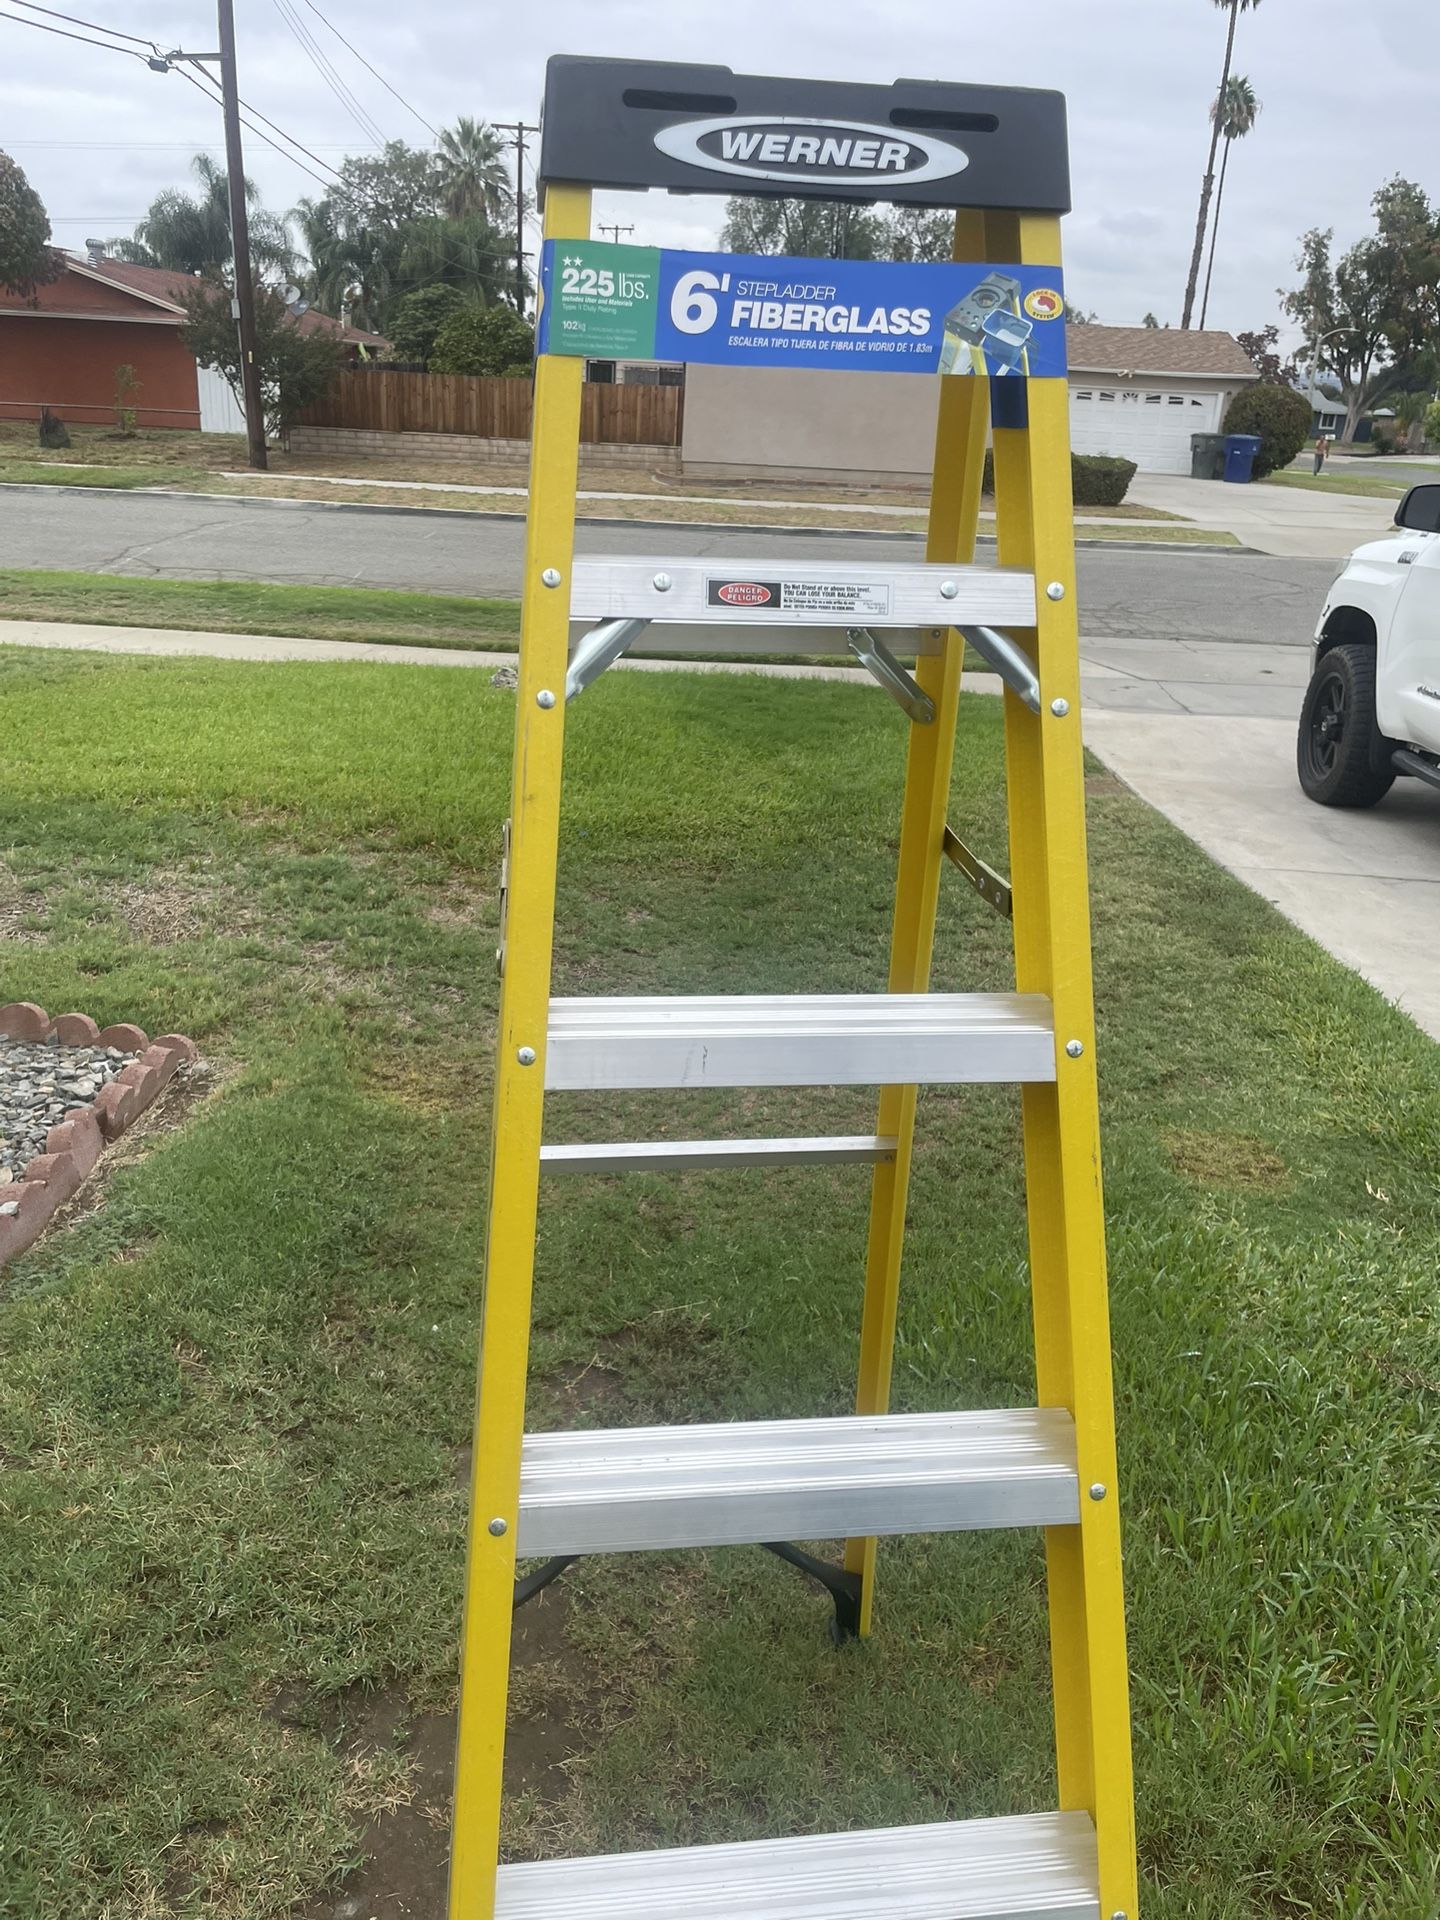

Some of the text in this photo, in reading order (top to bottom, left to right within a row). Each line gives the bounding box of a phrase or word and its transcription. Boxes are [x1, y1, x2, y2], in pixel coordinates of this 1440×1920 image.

[721, 131, 910, 170] WERNER
[562, 268, 649, 299] 225 lbs.
[737, 281, 836, 300] STEPLADDER
[671, 270, 731, 334] 6'
[731, 300, 931, 336] FIBERGLASS
[728, 336, 933, 353] ESCALERA TIPO TIJERA DE FIBRA DE VIDRIO DE 1.83m
[728, 586, 763, 594] DANGER
